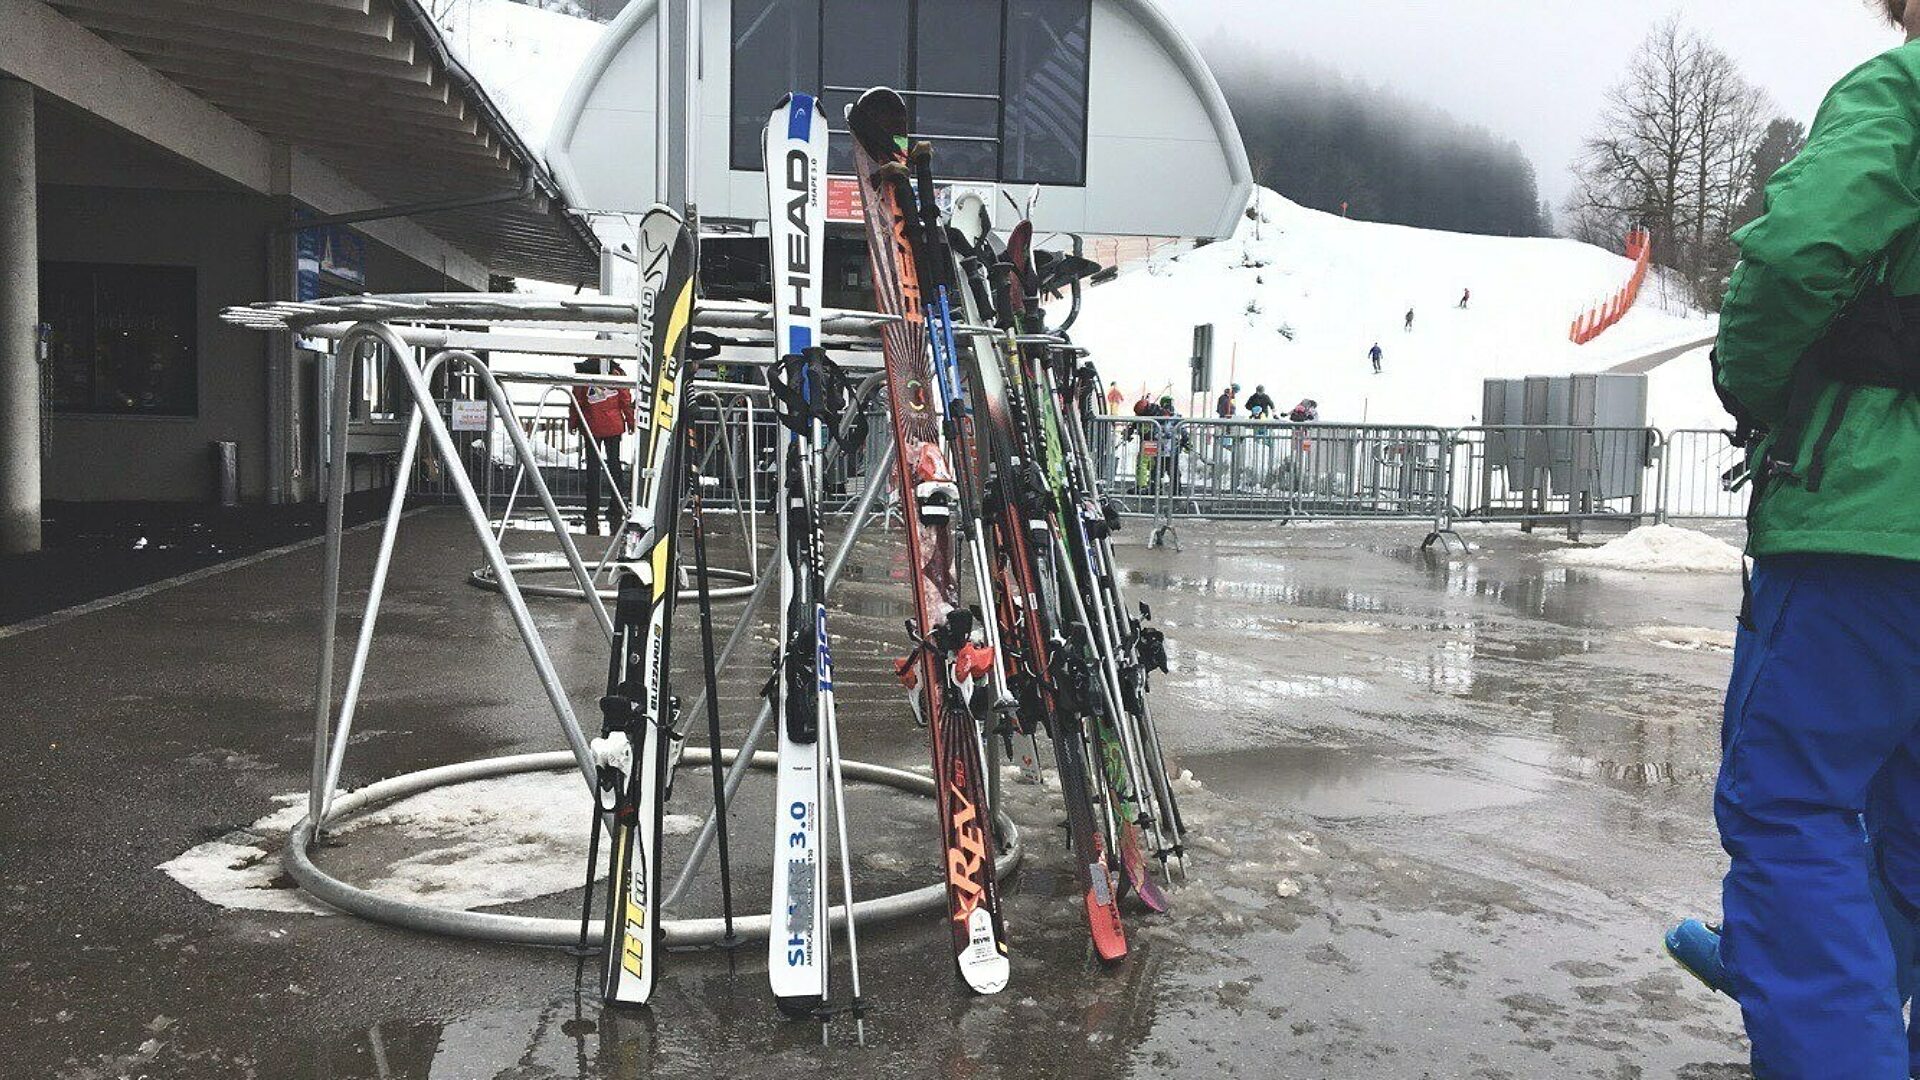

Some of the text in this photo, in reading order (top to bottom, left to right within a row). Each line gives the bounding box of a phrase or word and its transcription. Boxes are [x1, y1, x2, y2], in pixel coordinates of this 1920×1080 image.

[810, 158, 818, 207] SHAPE 3.0
[787, 149, 812, 317] HEAD
[636, 287, 656, 430] BLIZZARD
[650, 640, 661, 711] BLIZZARD
[789, 801, 806, 849] 3.0
[948, 780, 986, 905] REV
